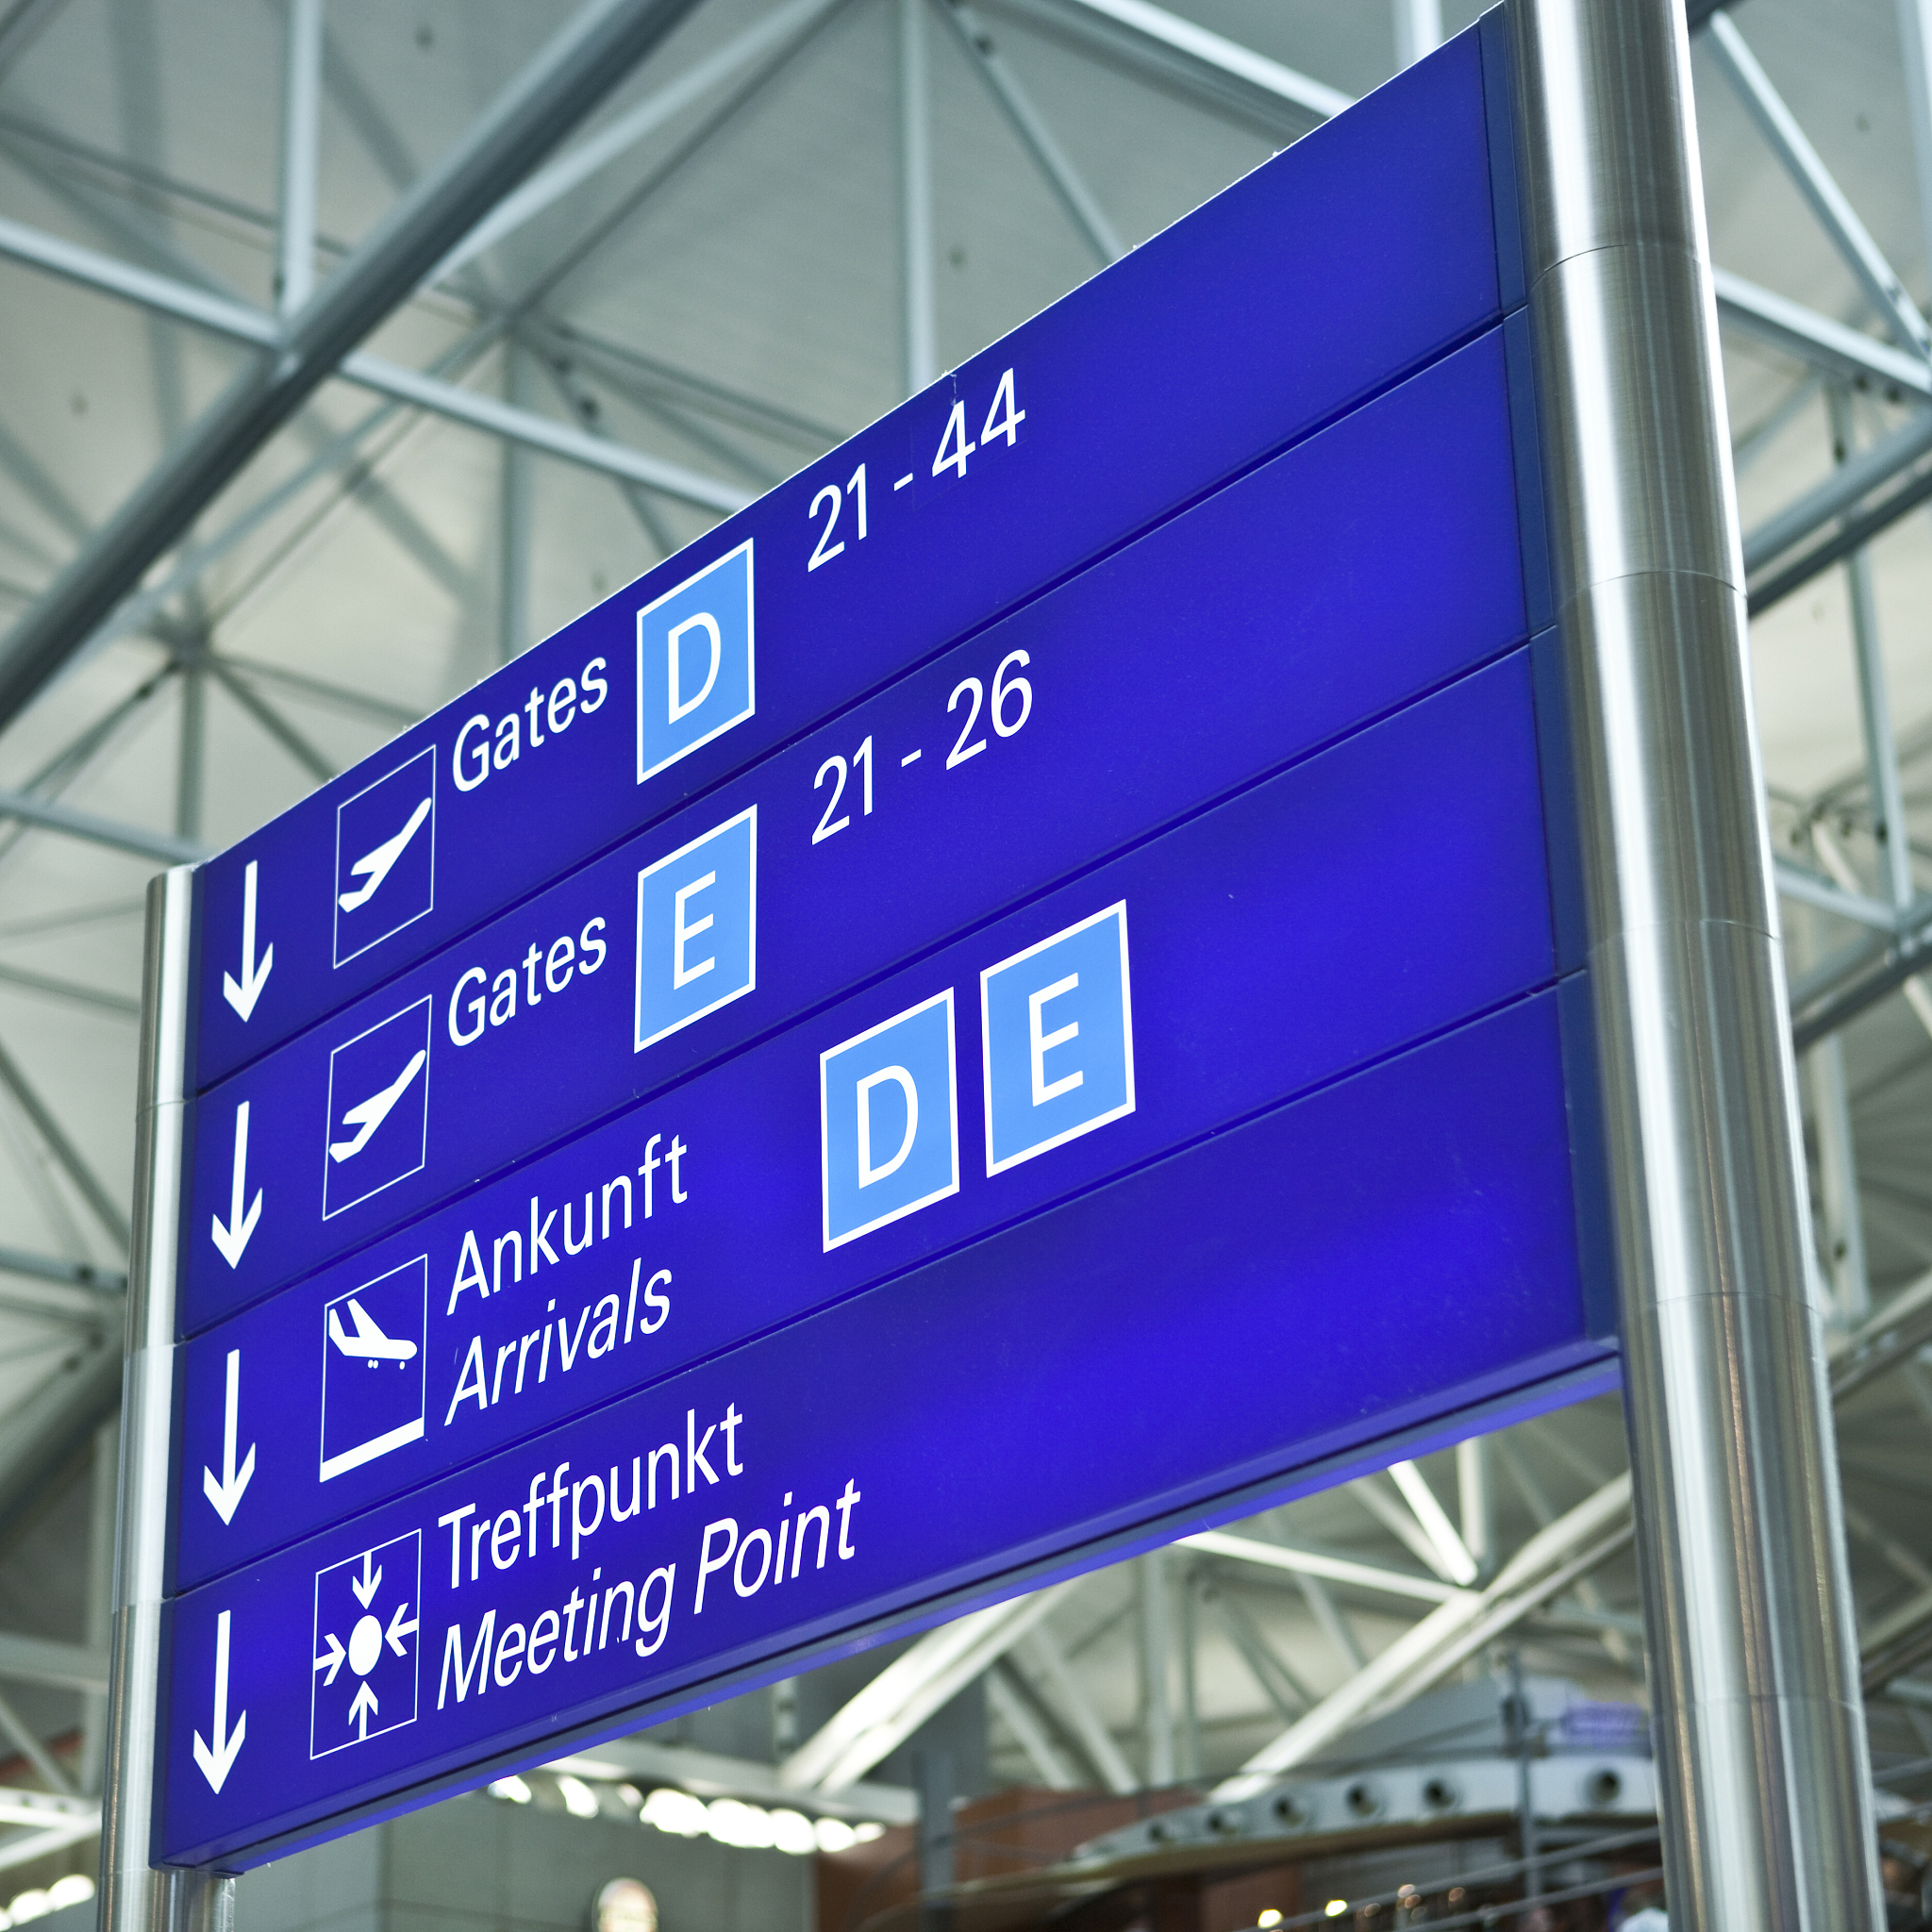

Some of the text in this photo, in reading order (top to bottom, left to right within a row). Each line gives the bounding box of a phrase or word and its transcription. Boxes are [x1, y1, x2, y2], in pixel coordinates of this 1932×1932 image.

[453, 657, 608, 792] Gates
[667, 611, 722, 725] D
[808, 462, 867, 573] 21
[931, 367, 1025, 478] 44
[448, 916, 607, 1047] Gates
[673, 870, 716, 991] E
[811, 735, 873, 845] 21
[945, 649, 1033, 771] 26
[856, 972, 1084, 1190] D E
[446, 1133, 688, 1316] Ankunft
[443, 1257, 673, 1426] Arrivals
[437, 1477, 861, 1710] Meeting Point
[438, 1402, 743, 1590] Treffpunkt
